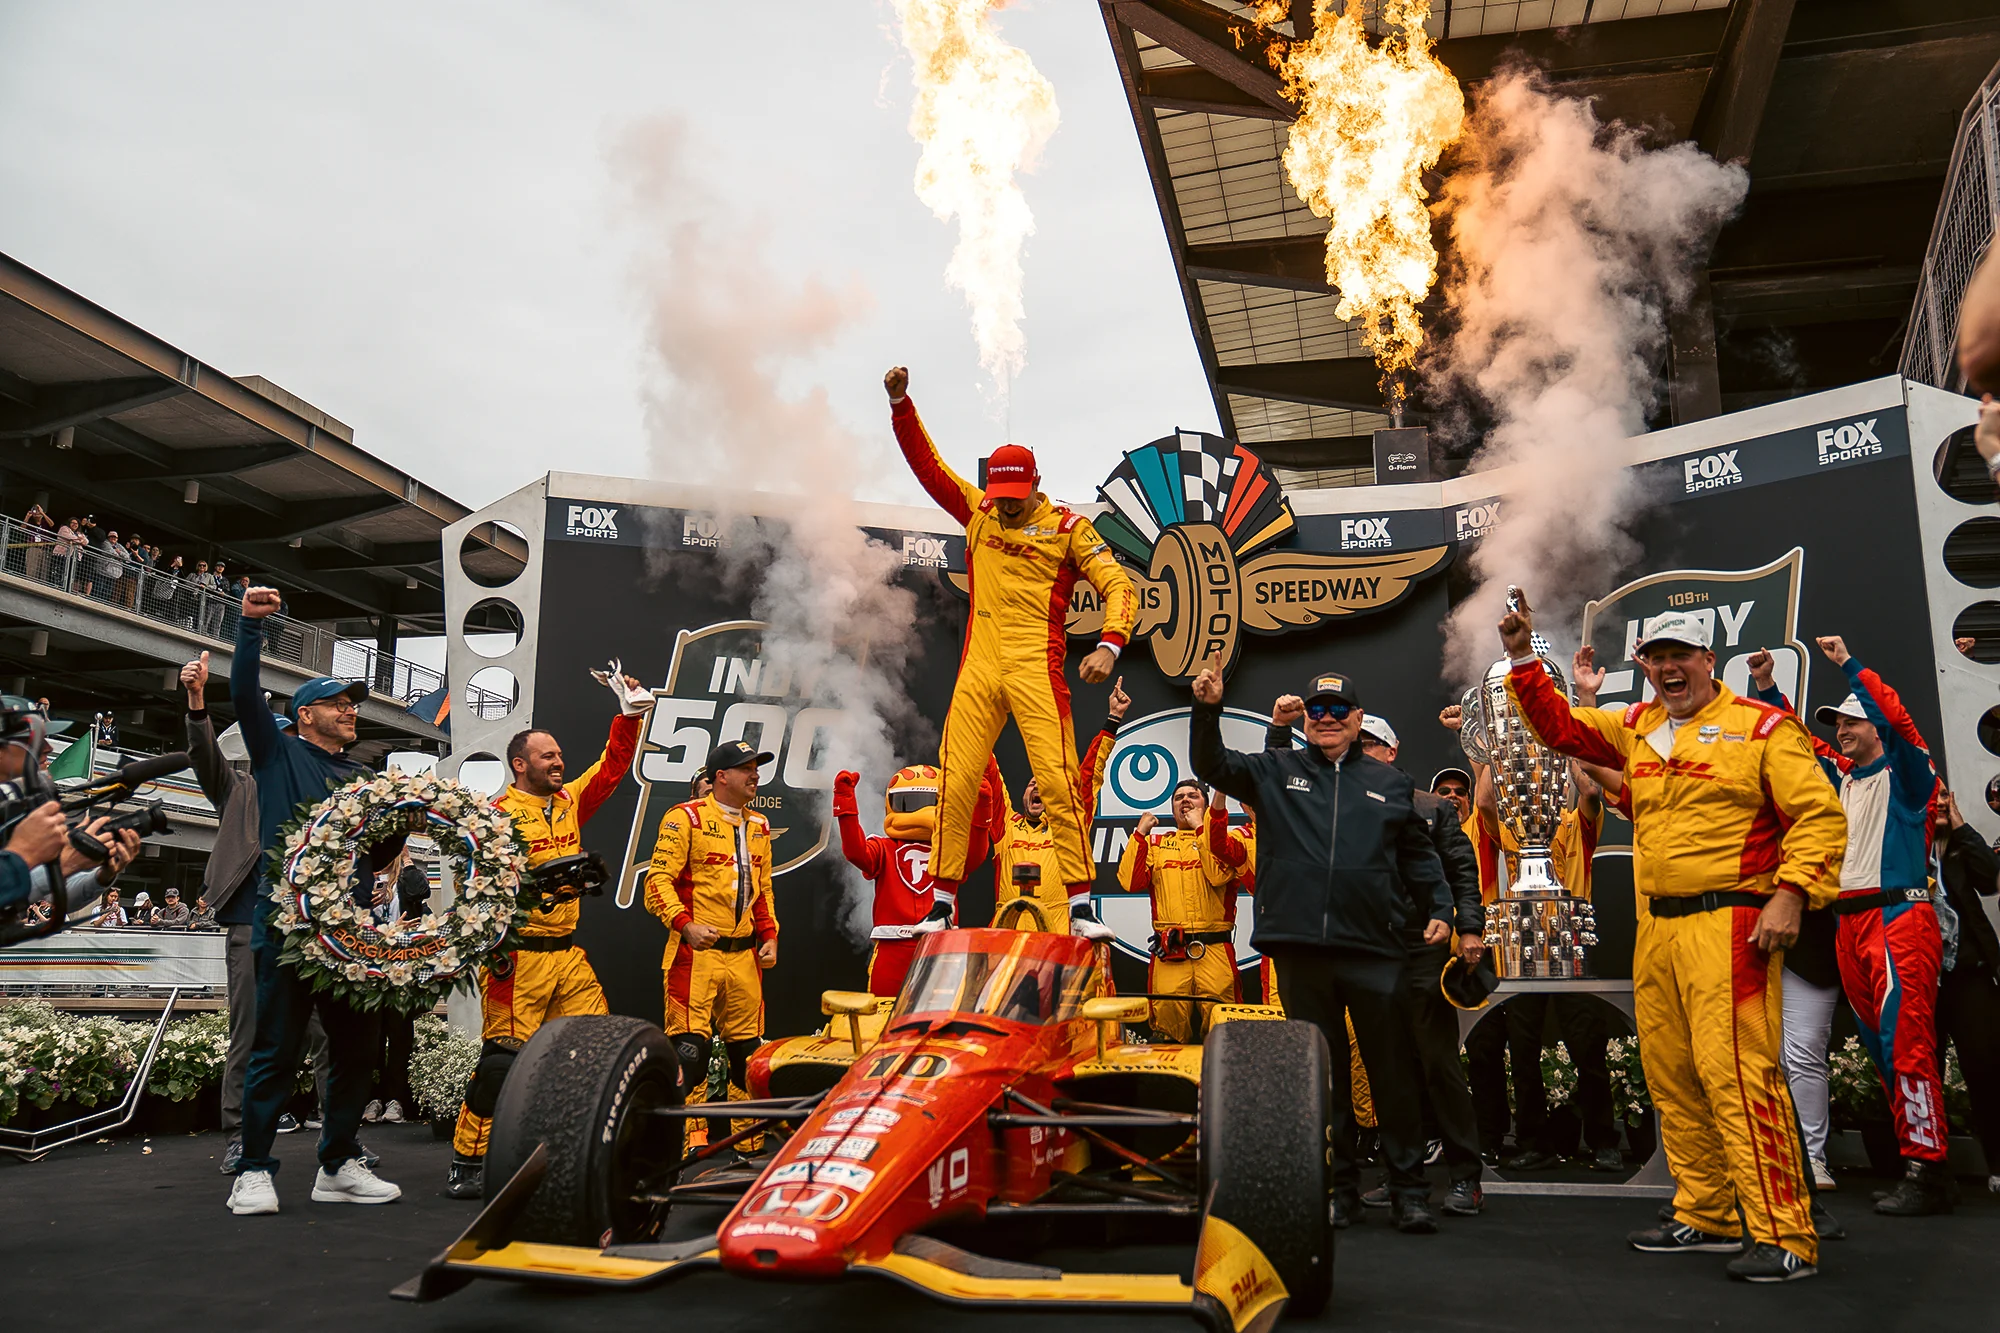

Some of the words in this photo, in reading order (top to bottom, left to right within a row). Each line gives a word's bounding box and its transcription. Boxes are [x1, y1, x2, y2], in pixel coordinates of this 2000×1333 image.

[1817, 419, 1879, 455] FOX
[1684, 449, 1740, 483] FOX
[1818, 444, 1882, 465] SPORTS
[989, 466, 1024, 475] Firestone
[1685, 473, 1743, 493] SPORTS
[567, 505, 618, 531] FOX
[1456, 502, 1500, 532] FOX
[566, 526, 618, 539] SPORTS
[1340, 518, 1391, 541] FOX
[1456, 525, 1500, 541] SPORT
[902, 536, 947, 559] FOX
[984, 534, 1040, 560] DHL
[1341, 539, 1392, 549] SPORTS
[902, 555, 949, 568] SPORTS
[1255, 577, 1382, 605] SPEEDWAY
[1667, 592, 1709, 607] 109TH
[1624, 601, 1755, 662] IDY
[1632, 758, 1715, 781] DHL
[744, 796, 782, 808] RIDGE
[332, 928, 449, 961] BORGWARNER
[1122, 1007, 1148, 1018] DHL
[863, 1051, 952, 1081] 10
[601, 1046, 649, 1145] Firestone
[1752, 1092, 1796, 1208] DHL
